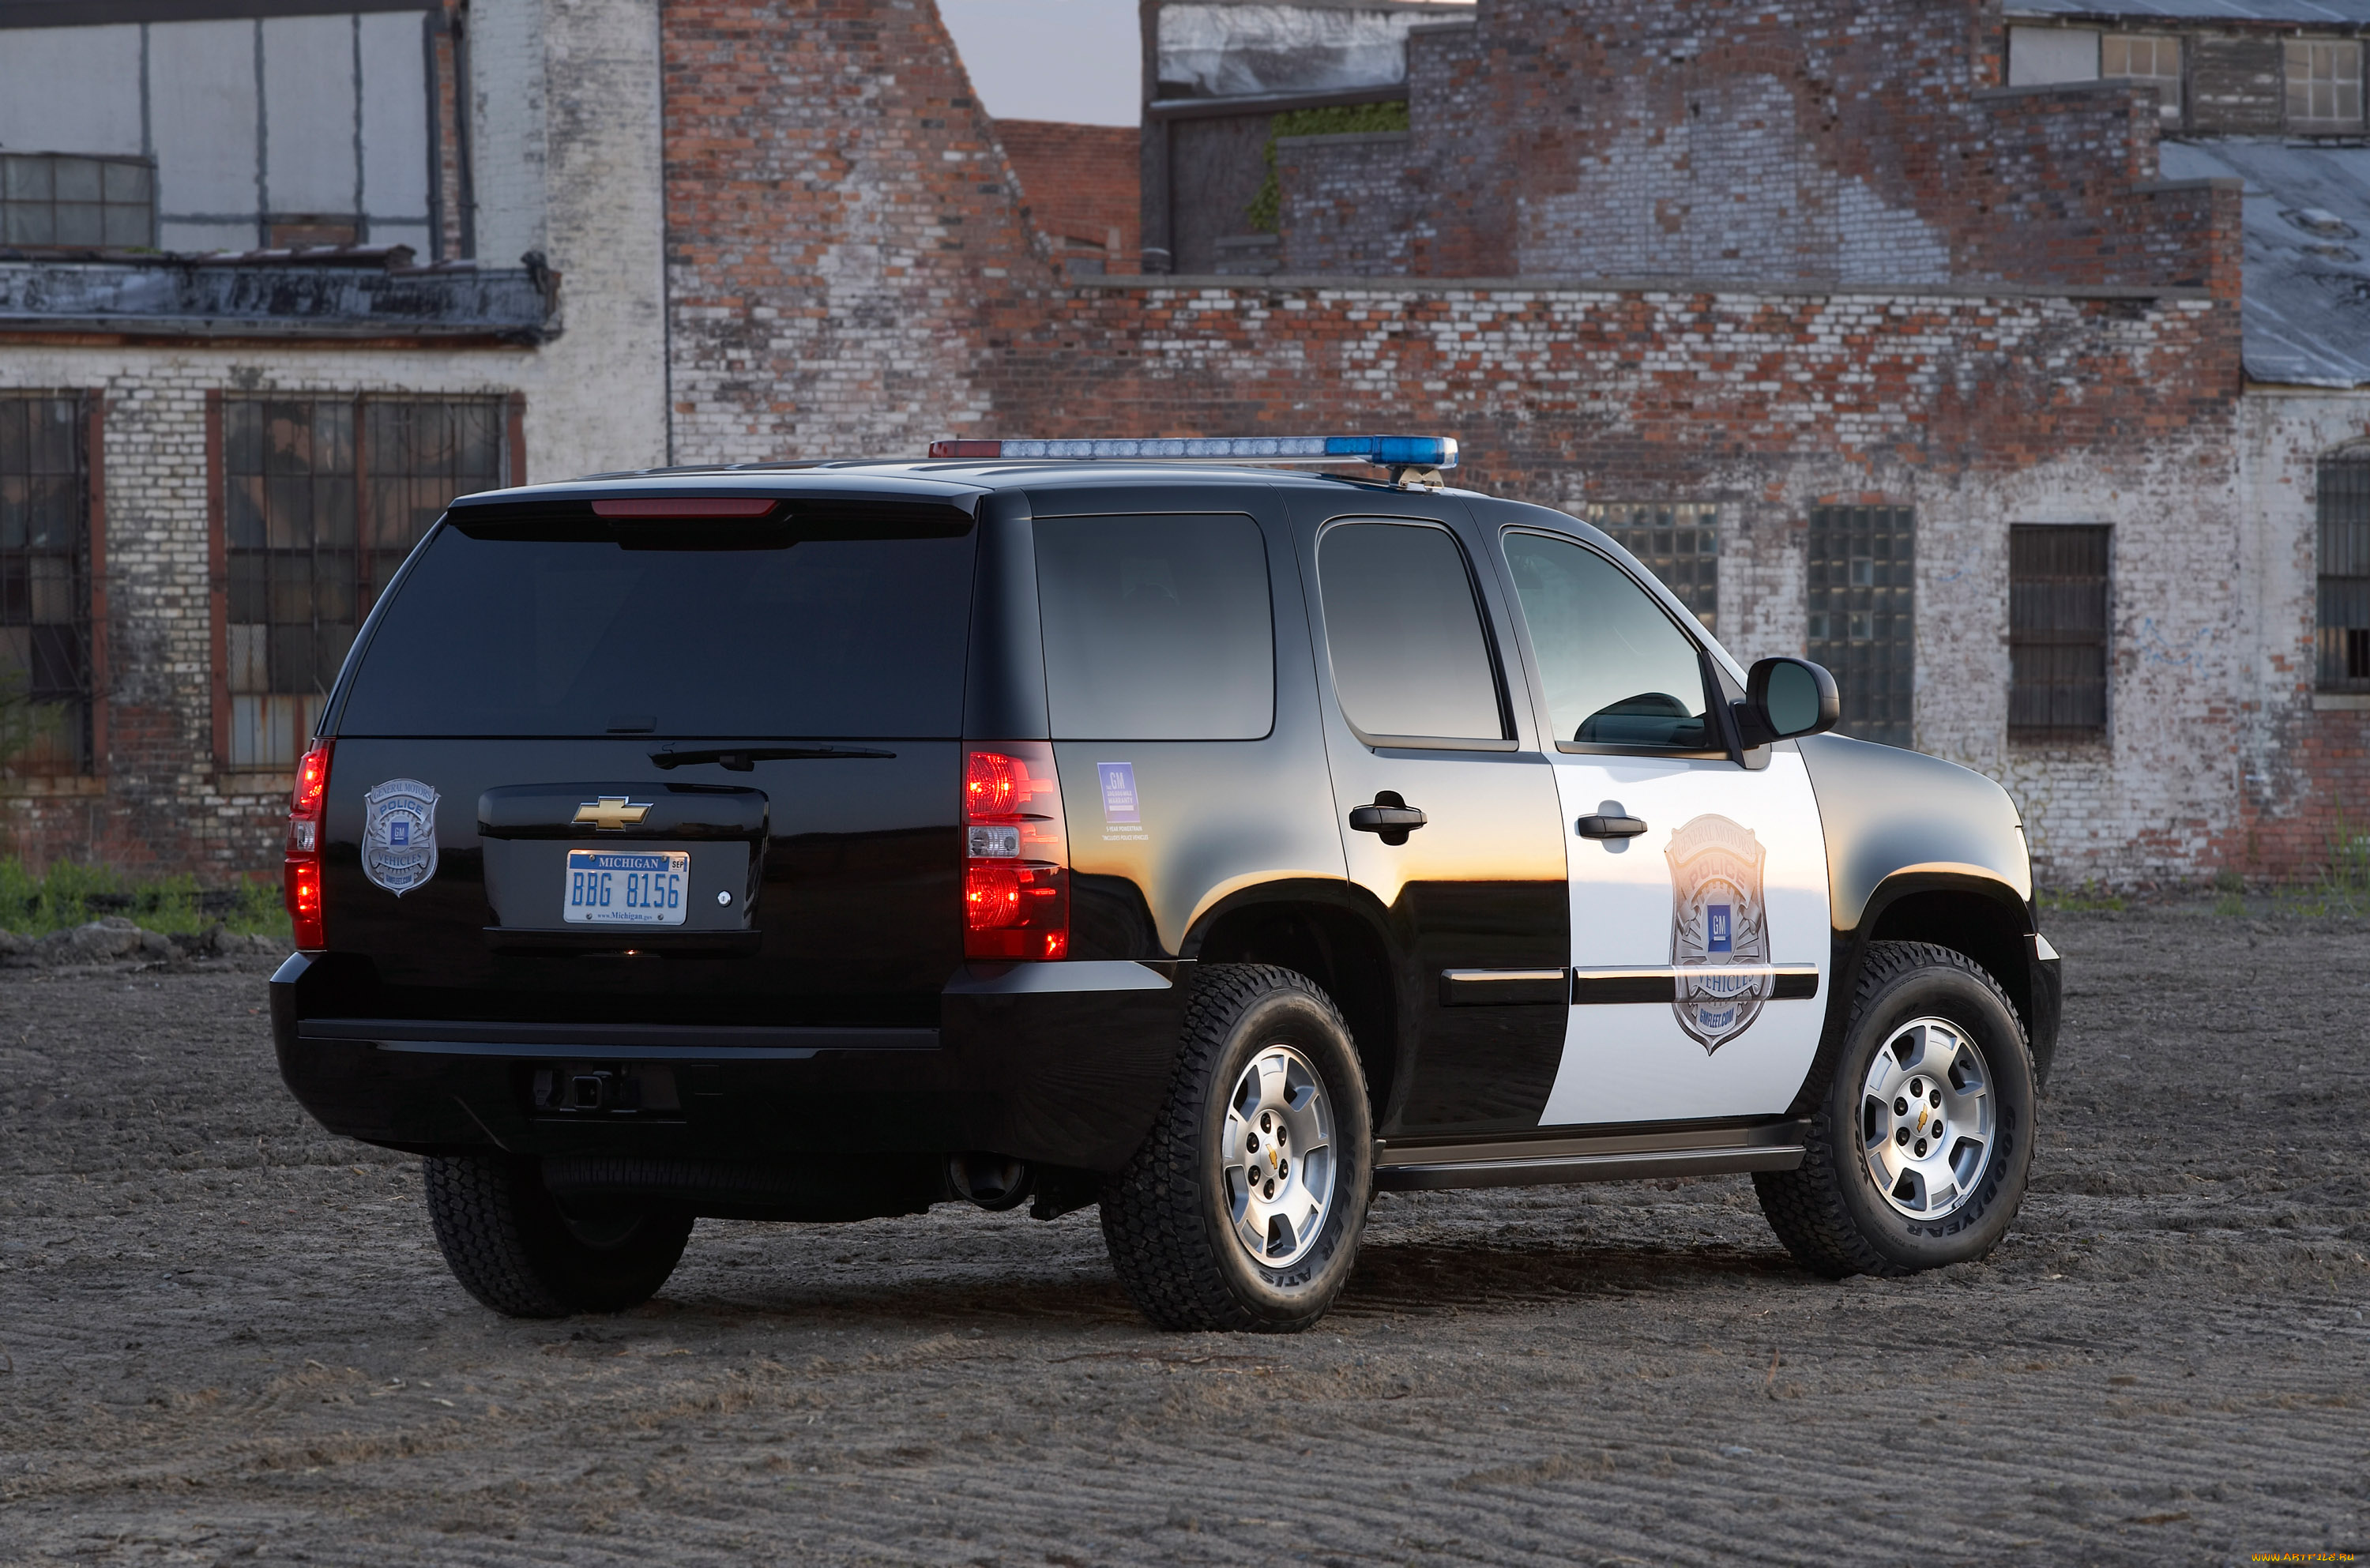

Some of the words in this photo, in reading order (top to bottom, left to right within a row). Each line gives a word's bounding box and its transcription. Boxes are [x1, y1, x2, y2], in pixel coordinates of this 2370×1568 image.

[1109, 772, 1125, 789] GM
[374, 784, 403, 799] GENERAL
[404, 783, 431, 800] MOTORS
[379, 799, 423, 815] POLICE
[394, 827, 404, 837] GM
[1676, 827, 1714, 855] GENERAL
[1716, 825, 1753, 855] MOTORS
[378, 852, 422, 867] VEHICLES
[599, 857, 659, 869] MICHIGAN
[386, 874, 412, 886] GMFLEET.COM
[1689, 858, 1747, 890] POLICE
[571, 872, 612, 906] BBG
[626, 873, 679, 908] 8156
[597, 911, 653, 921] www.Michigan.gov
[1713, 915, 1727, 934] GM
[1699, 1007, 1736, 1028] GMFLEET.COM
[1907, 1105, 2016, 1239] GOODYEAR
